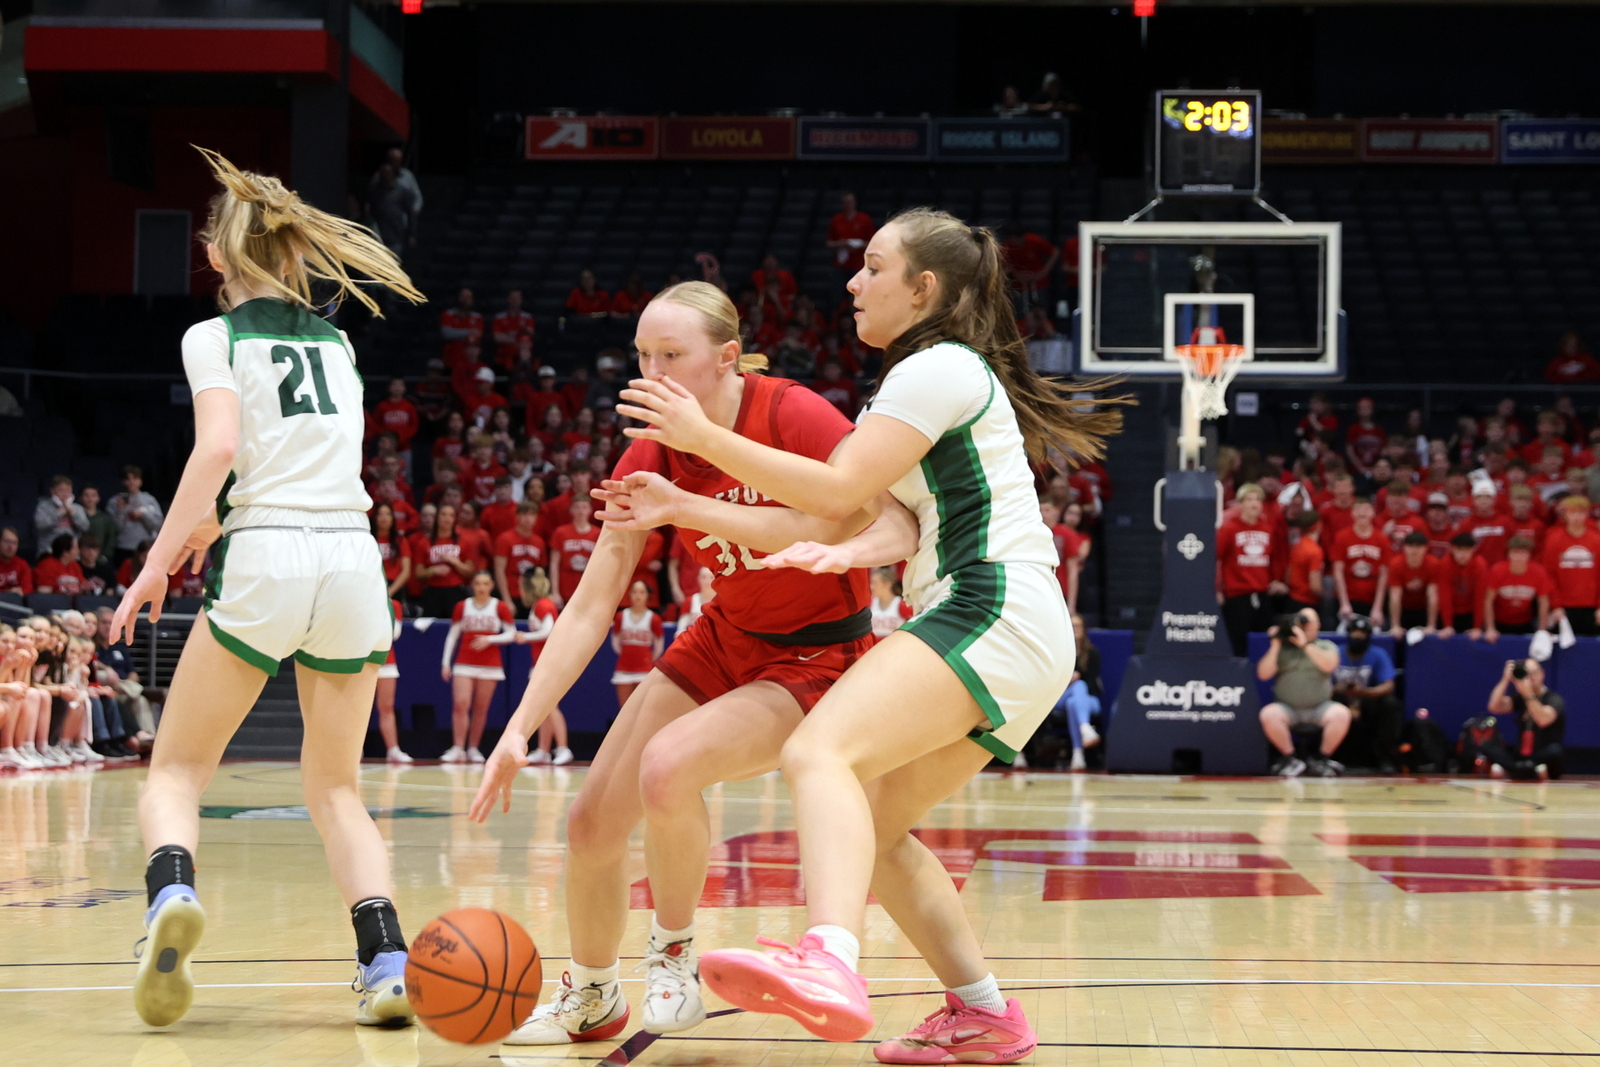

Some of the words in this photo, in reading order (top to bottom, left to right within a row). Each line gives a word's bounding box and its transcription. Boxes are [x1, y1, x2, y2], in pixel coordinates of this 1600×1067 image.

[1183, 100, 1250, 132] 2:03
[691, 127, 764, 148] LOYOLA
[1508, 131, 1566, 150] SAINT
[270, 344, 340, 418] 21
[1162, 611, 1219, 627] Premier
[1166, 627, 1215, 643] Health
[1136, 679, 1246, 711] altafiber
